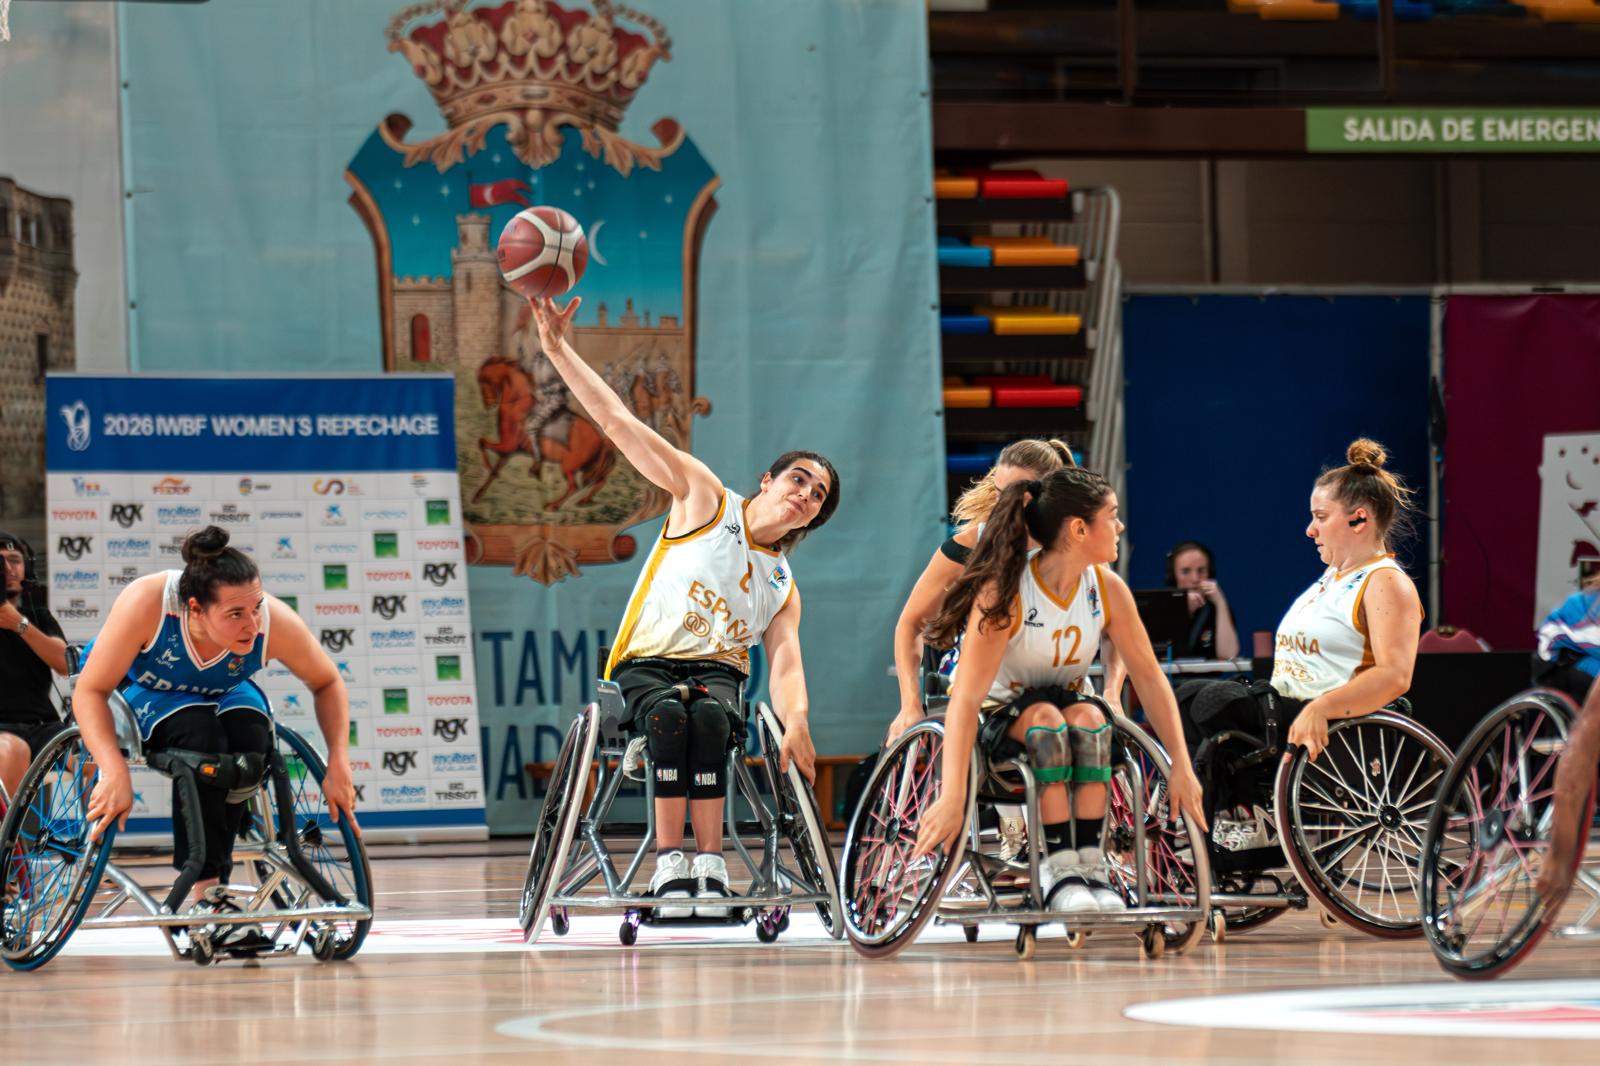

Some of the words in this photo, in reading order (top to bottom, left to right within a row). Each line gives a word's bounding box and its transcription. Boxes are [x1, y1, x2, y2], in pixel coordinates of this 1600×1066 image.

[1344, 117, 1434, 141] SALIDA
[1442, 117, 1475, 141] DE
[104, 414, 153, 436] 2026
[156, 415, 207, 436] IWBF
[317, 415, 439, 435] REPECHAGE
[52, 510, 97, 520] TOYOTA
[416, 540, 460, 550] TOYOTA
[366, 571, 412, 581] TOYOTA
[56, 609, 99, 619] TISSOT
[315, 604, 361, 615] TOYOTA
[423, 635, 467, 645] TISSOT
[1051, 625, 1082, 668] 12
[427, 695, 473, 706] TOYOTA
[376, 727, 423, 737] TOYOTA
[662, 769, 678, 781] NBA
[701, 772, 717, 785] NBA
[434, 791, 478, 800] TISSOT
